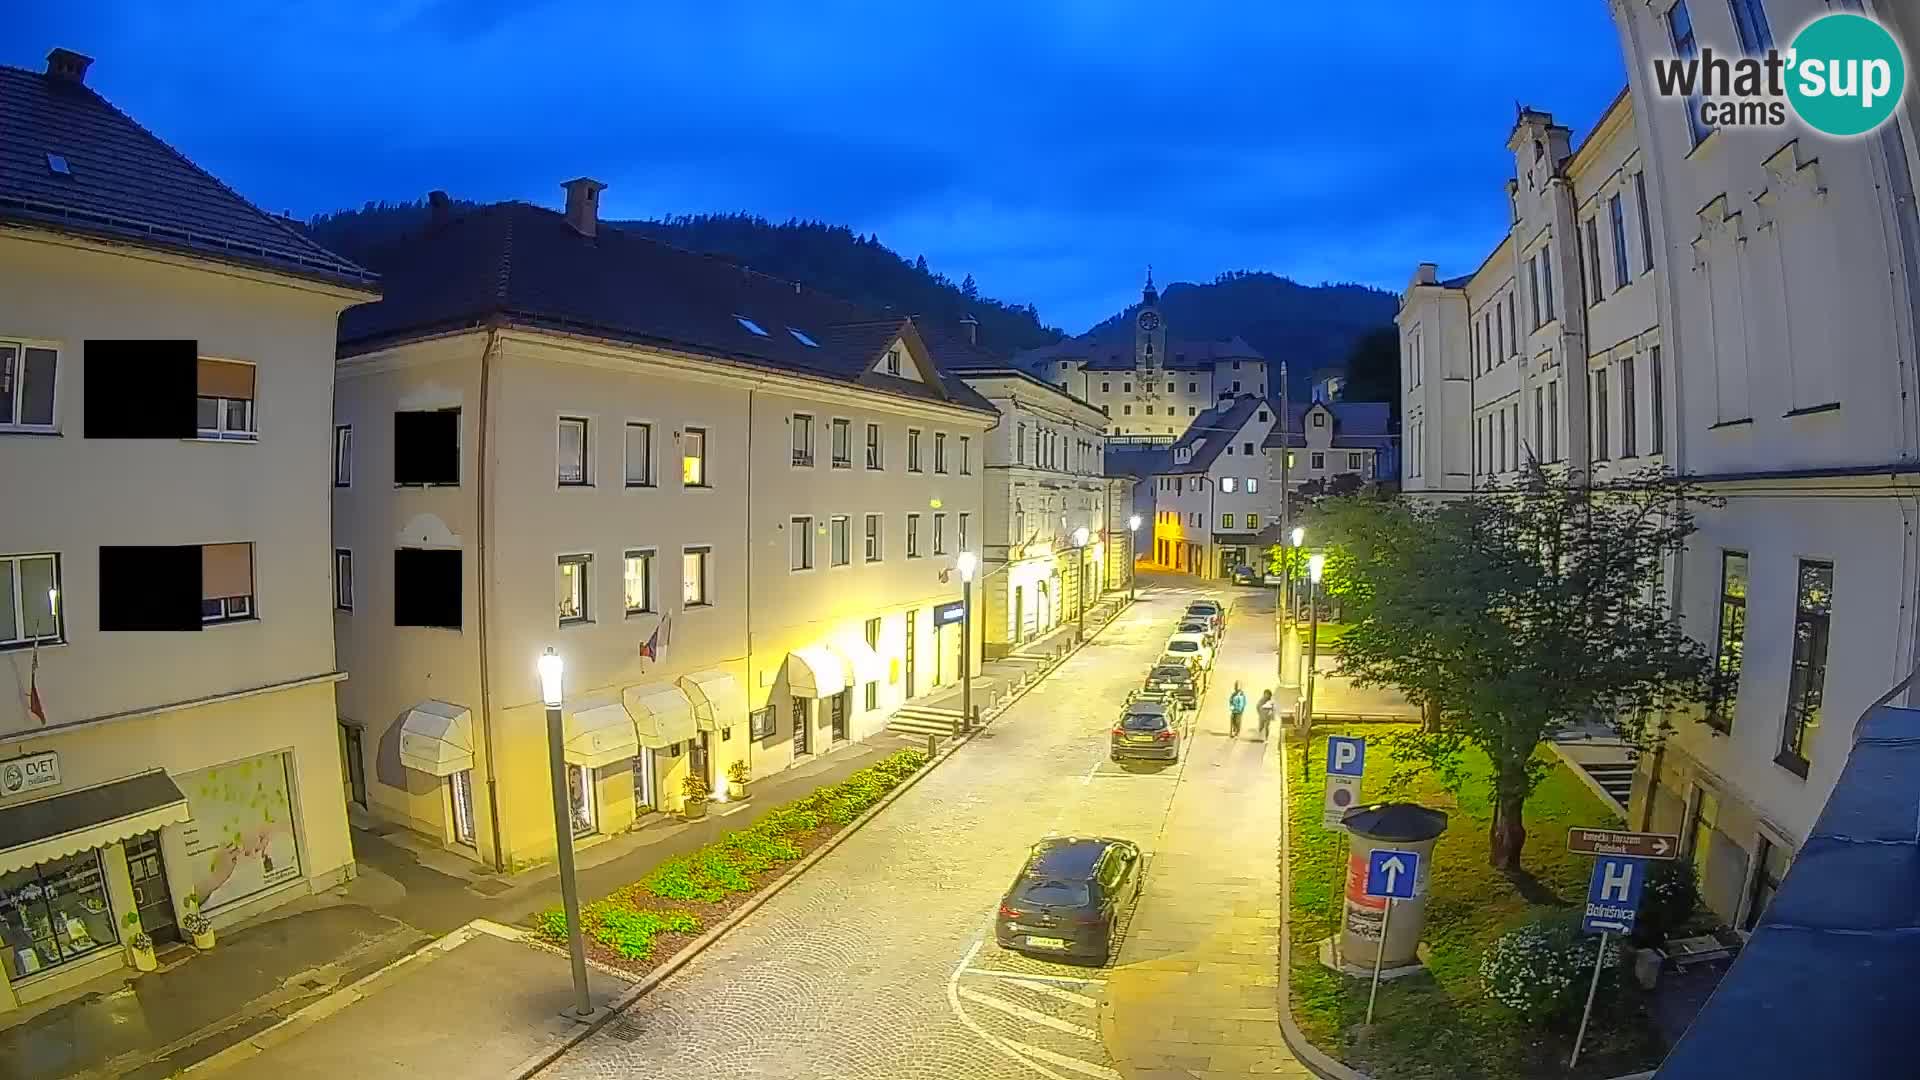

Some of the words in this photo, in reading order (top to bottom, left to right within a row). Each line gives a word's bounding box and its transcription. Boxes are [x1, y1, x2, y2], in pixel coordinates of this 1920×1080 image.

[1335, 742, 1356, 770] P
[26, 759, 54, 776] CVET
[1601, 862, 1633, 902] H
[1586, 903, 1634, 920] Bolnišnica
